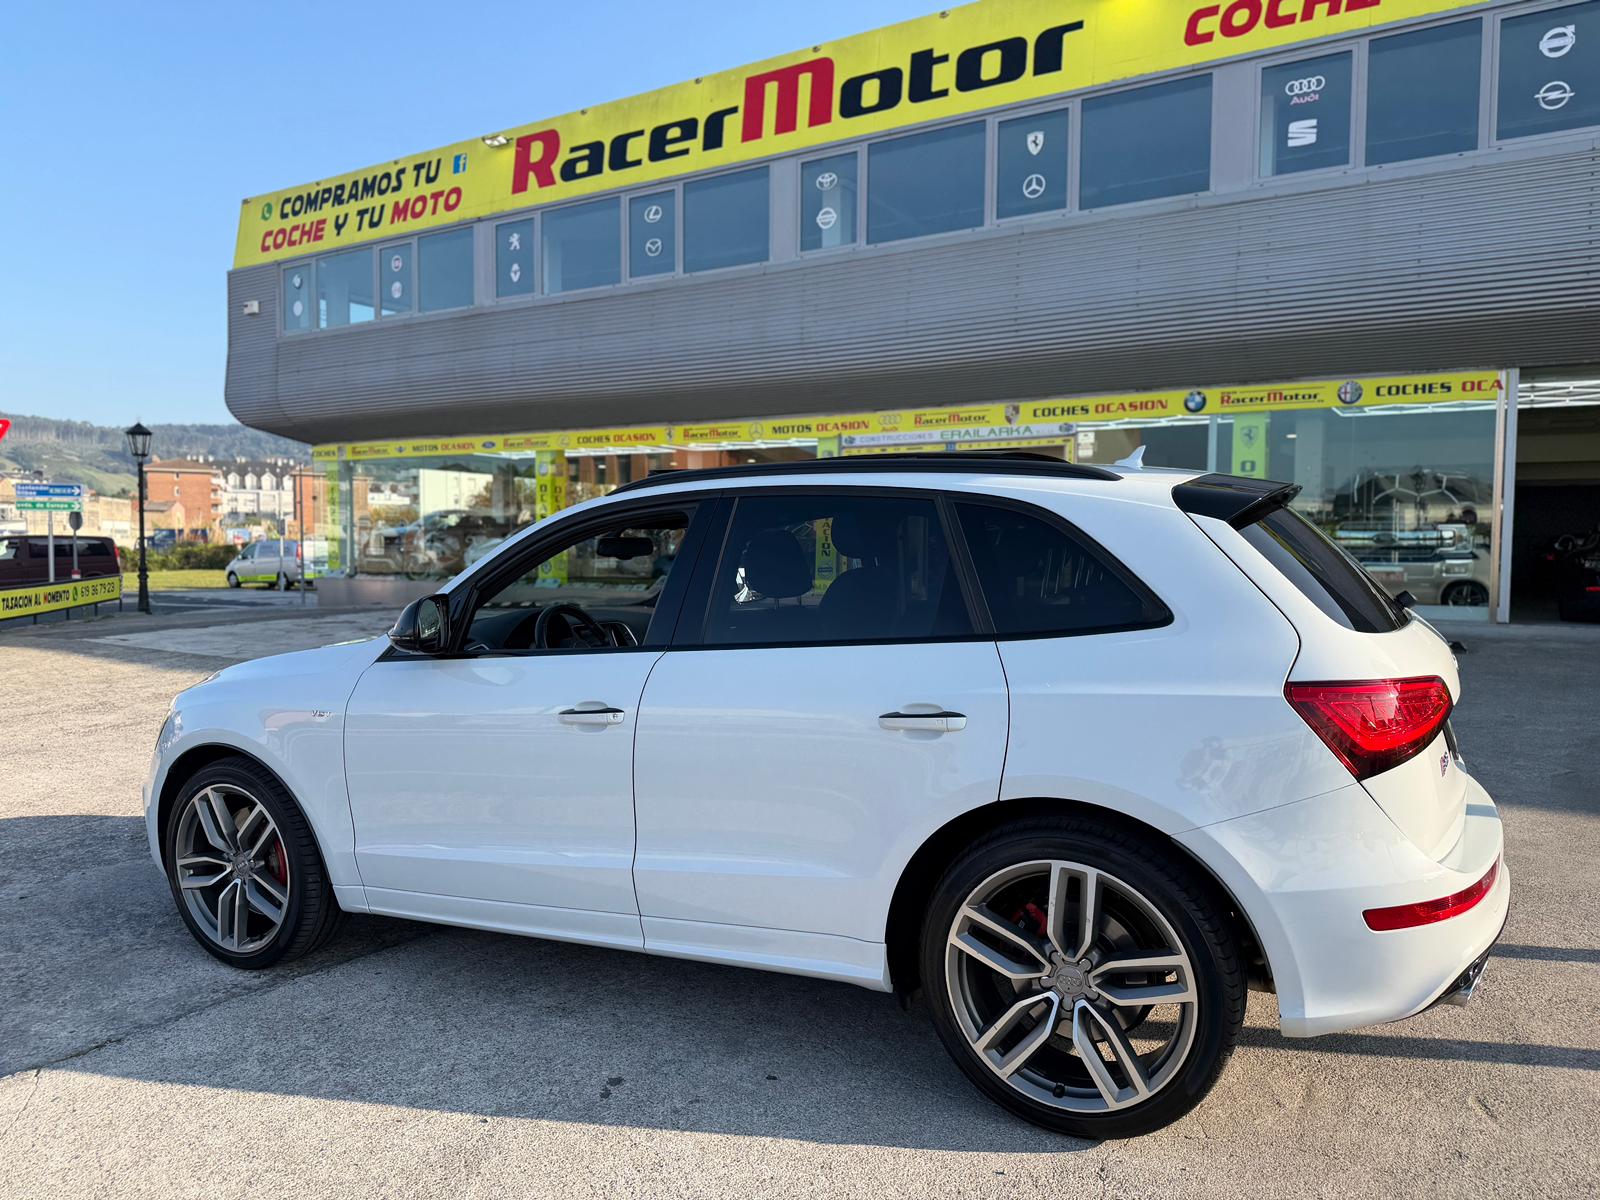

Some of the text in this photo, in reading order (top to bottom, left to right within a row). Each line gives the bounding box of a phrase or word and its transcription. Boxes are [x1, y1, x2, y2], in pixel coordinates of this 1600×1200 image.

[511, 20, 1085, 194] RacerMotor
[1289, 93, 1320, 106] Audi
[280, 158, 442, 220] COMPRAMOS TU
[260, 186, 463, 253] COCHE Y TU MOTO
[1375, 379, 1504, 397] COCHES OCA
[1220, 391, 1320, 405] RacerMotor
[1033, 399, 1168, 418] COCHES OCASION
[914, 413, 986, 426] RacerMotor
[683, 427, 741, 439] RacerMotor
[772, 420, 869, 435] MOTOS OCASION
[940, 425, 1033, 440] ERAILARKA
[577, 433, 656, 444] COCHES OCASION
[412, 444, 438, 452] MOTOS
[440, 442, 475, 450] OCASION
[2, 595, 33, 611] TASACION
[34, 593, 42, 606] AL
[43, 590, 70, 605] MOMENTO
